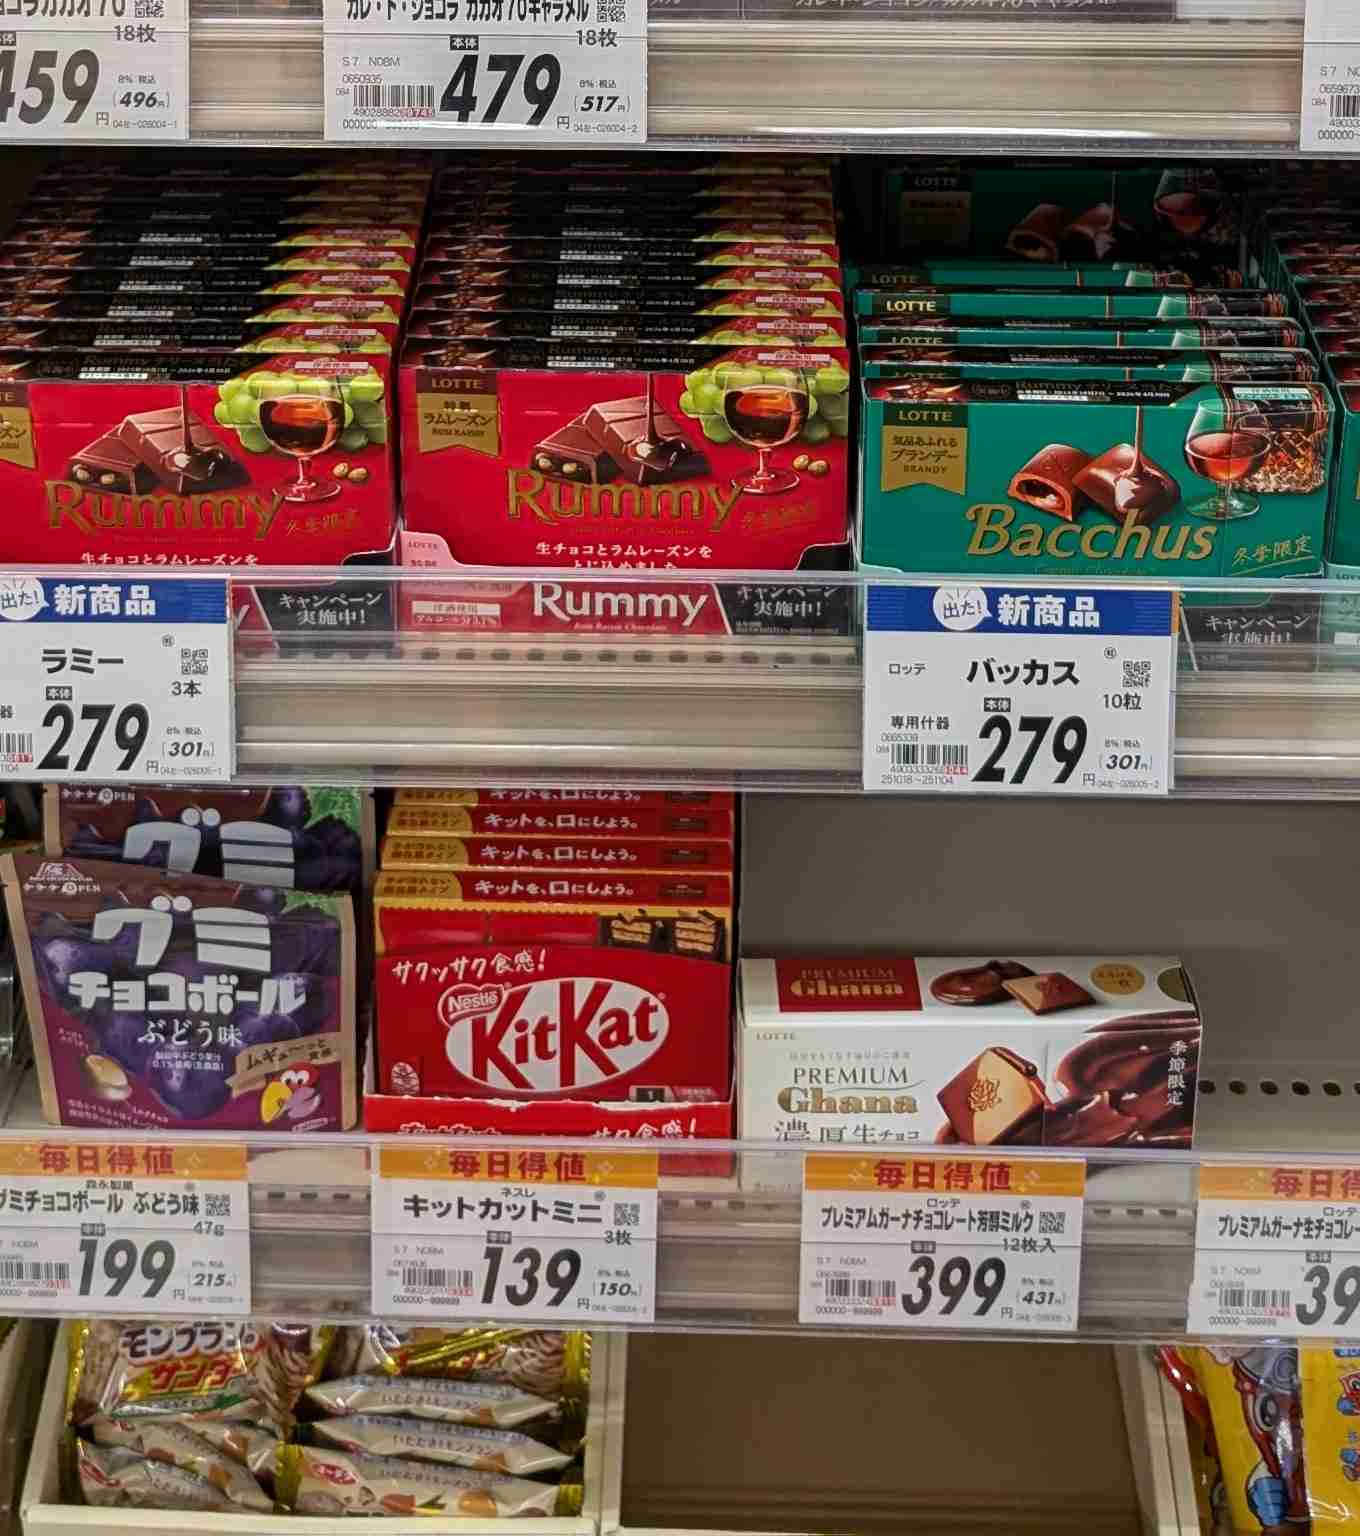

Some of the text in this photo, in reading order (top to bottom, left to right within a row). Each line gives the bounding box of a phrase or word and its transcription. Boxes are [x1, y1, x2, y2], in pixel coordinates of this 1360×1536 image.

[115, 25, 158, 44] 18枚
[576, 27, 617, 47] 18枚
[439, 53, 562, 130] 479
[965, 503, 1218, 561] Bacchus
[536, 542, 714, 559] 生チョコとラムレーズンを
[53, 584, 157, 617] 新商品
[533, 583, 709, 625] Rummy
[997, 594, 1101, 629] 新商品
[42, 649, 125, 675] ラミー
[966, 659, 1081, 687] バッカス
[171, 679, 201, 698] 3本
[1102, 693, 1141, 711] 10粒
[35, 703, 150, 773] 279
[971, 715, 1088, 786] 279
[93, 895, 272, 973] グミ
[138, 1019, 242, 1047] ぶどう味
[471, 980, 659, 1091] KitKat
[777, 1087, 919, 1115] Ghana
[874, 1159, 1011, 1190] 毎日得値
[133, 1191, 200, 1216] ぶどう味
[402, 1194, 604, 1225] キットカットミニ
[604, 1228, 632, 1246] 3枚
[1002, 1238, 1056, 1253] 12枚入
[77, 1238, 176, 1300] 199
[481, 1246, 582, 1308] 139
[902, 1256, 1006, 1316] 399
